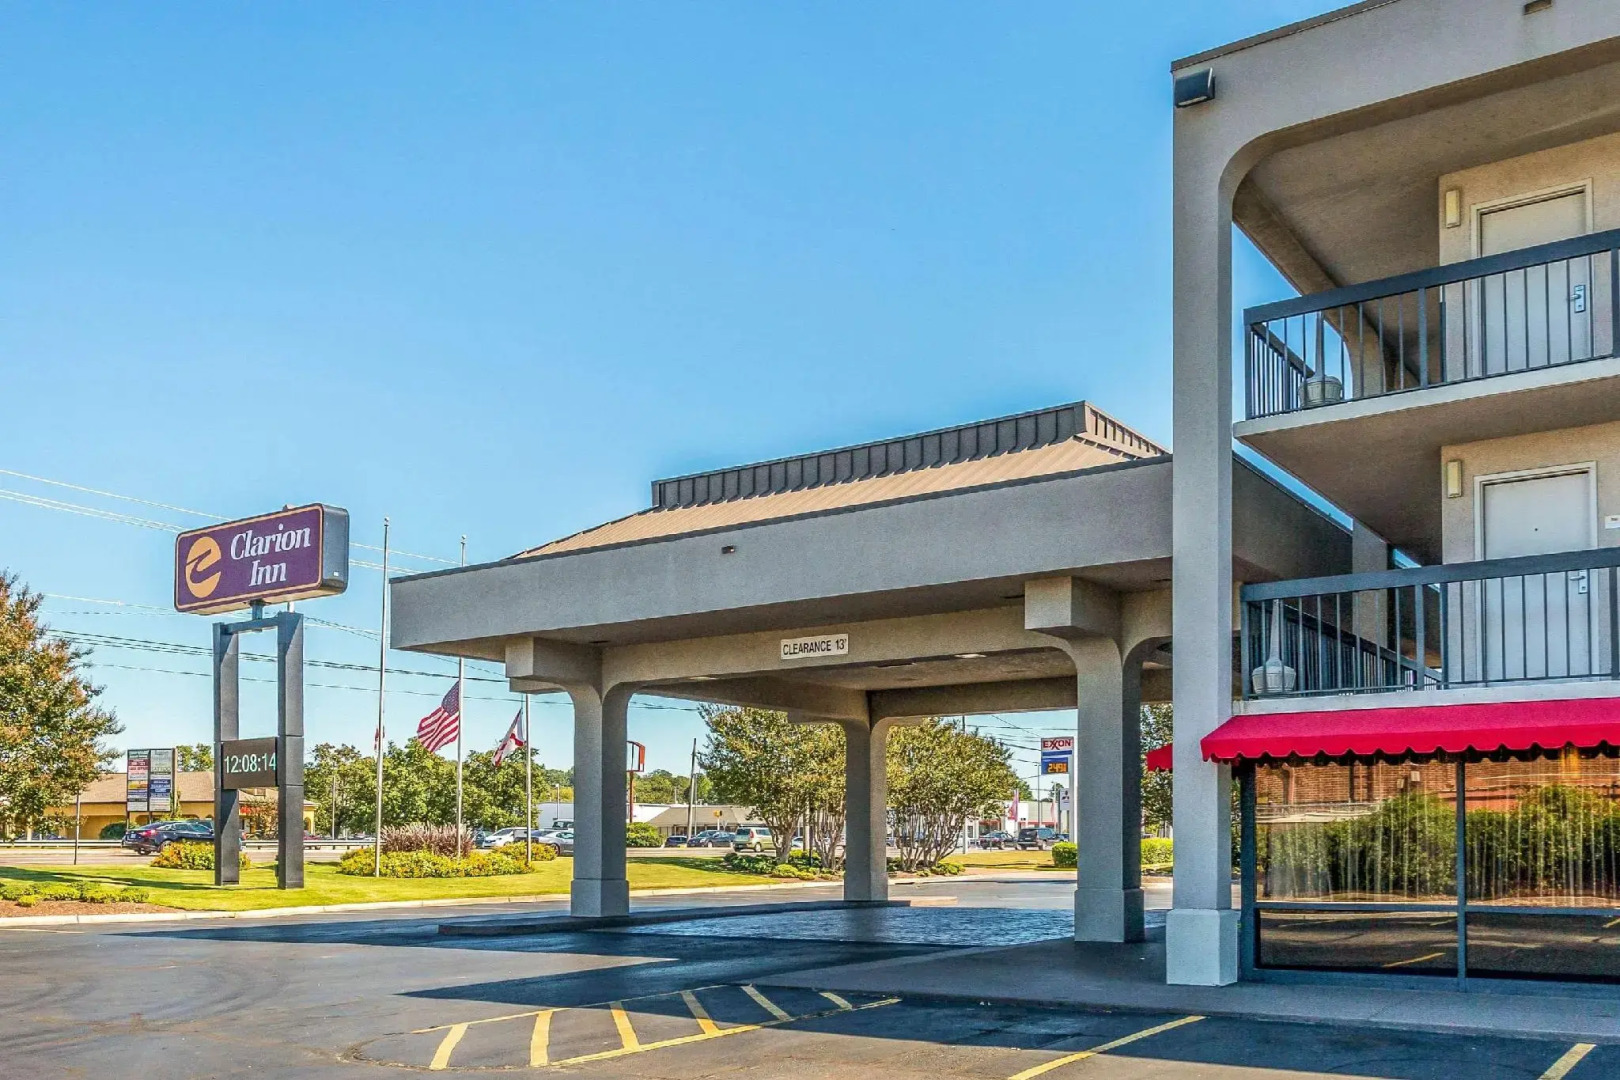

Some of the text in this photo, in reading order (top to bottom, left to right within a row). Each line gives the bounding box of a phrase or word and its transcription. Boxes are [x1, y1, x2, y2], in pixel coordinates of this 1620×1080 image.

[230, 523, 311, 560] Clarion
[248, 559, 287, 587] Inn
[782, 640, 832, 656] CLEARANCE
[1042, 738, 1072, 750] EXXON
[223, 752, 276, 774] 12:08:14
